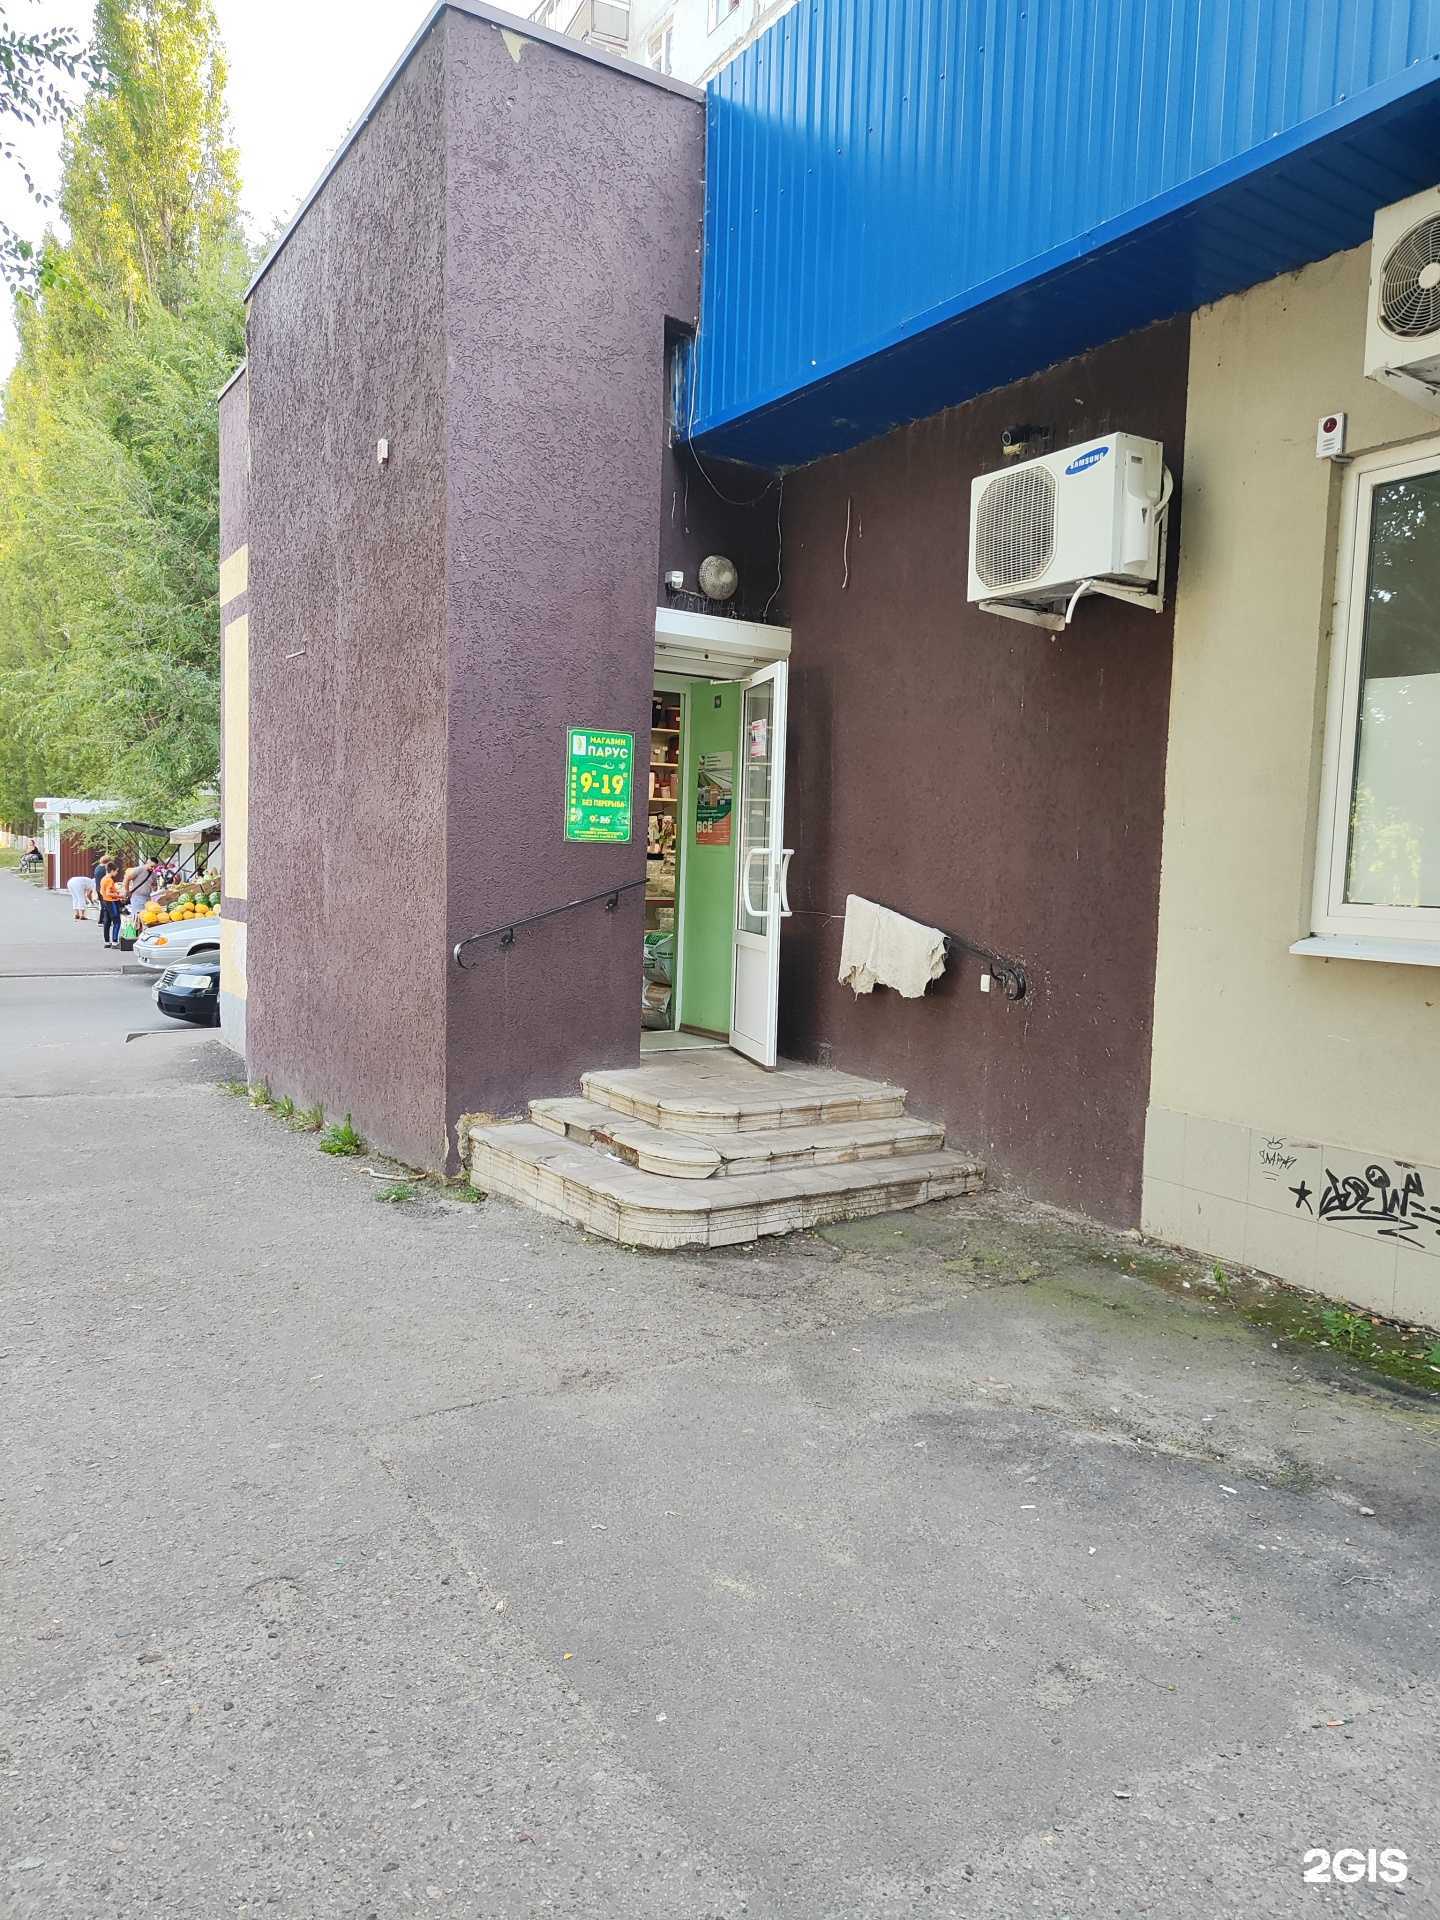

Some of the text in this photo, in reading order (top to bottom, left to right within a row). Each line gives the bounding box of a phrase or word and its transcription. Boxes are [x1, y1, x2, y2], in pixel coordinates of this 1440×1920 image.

[1070, 452, 1105, 469] SAMSUNG
[590, 736, 626, 746] МАГАЗИН
[587, 745, 629, 758] ПАРУС
[696, 818, 713, 833] ВСЁ
